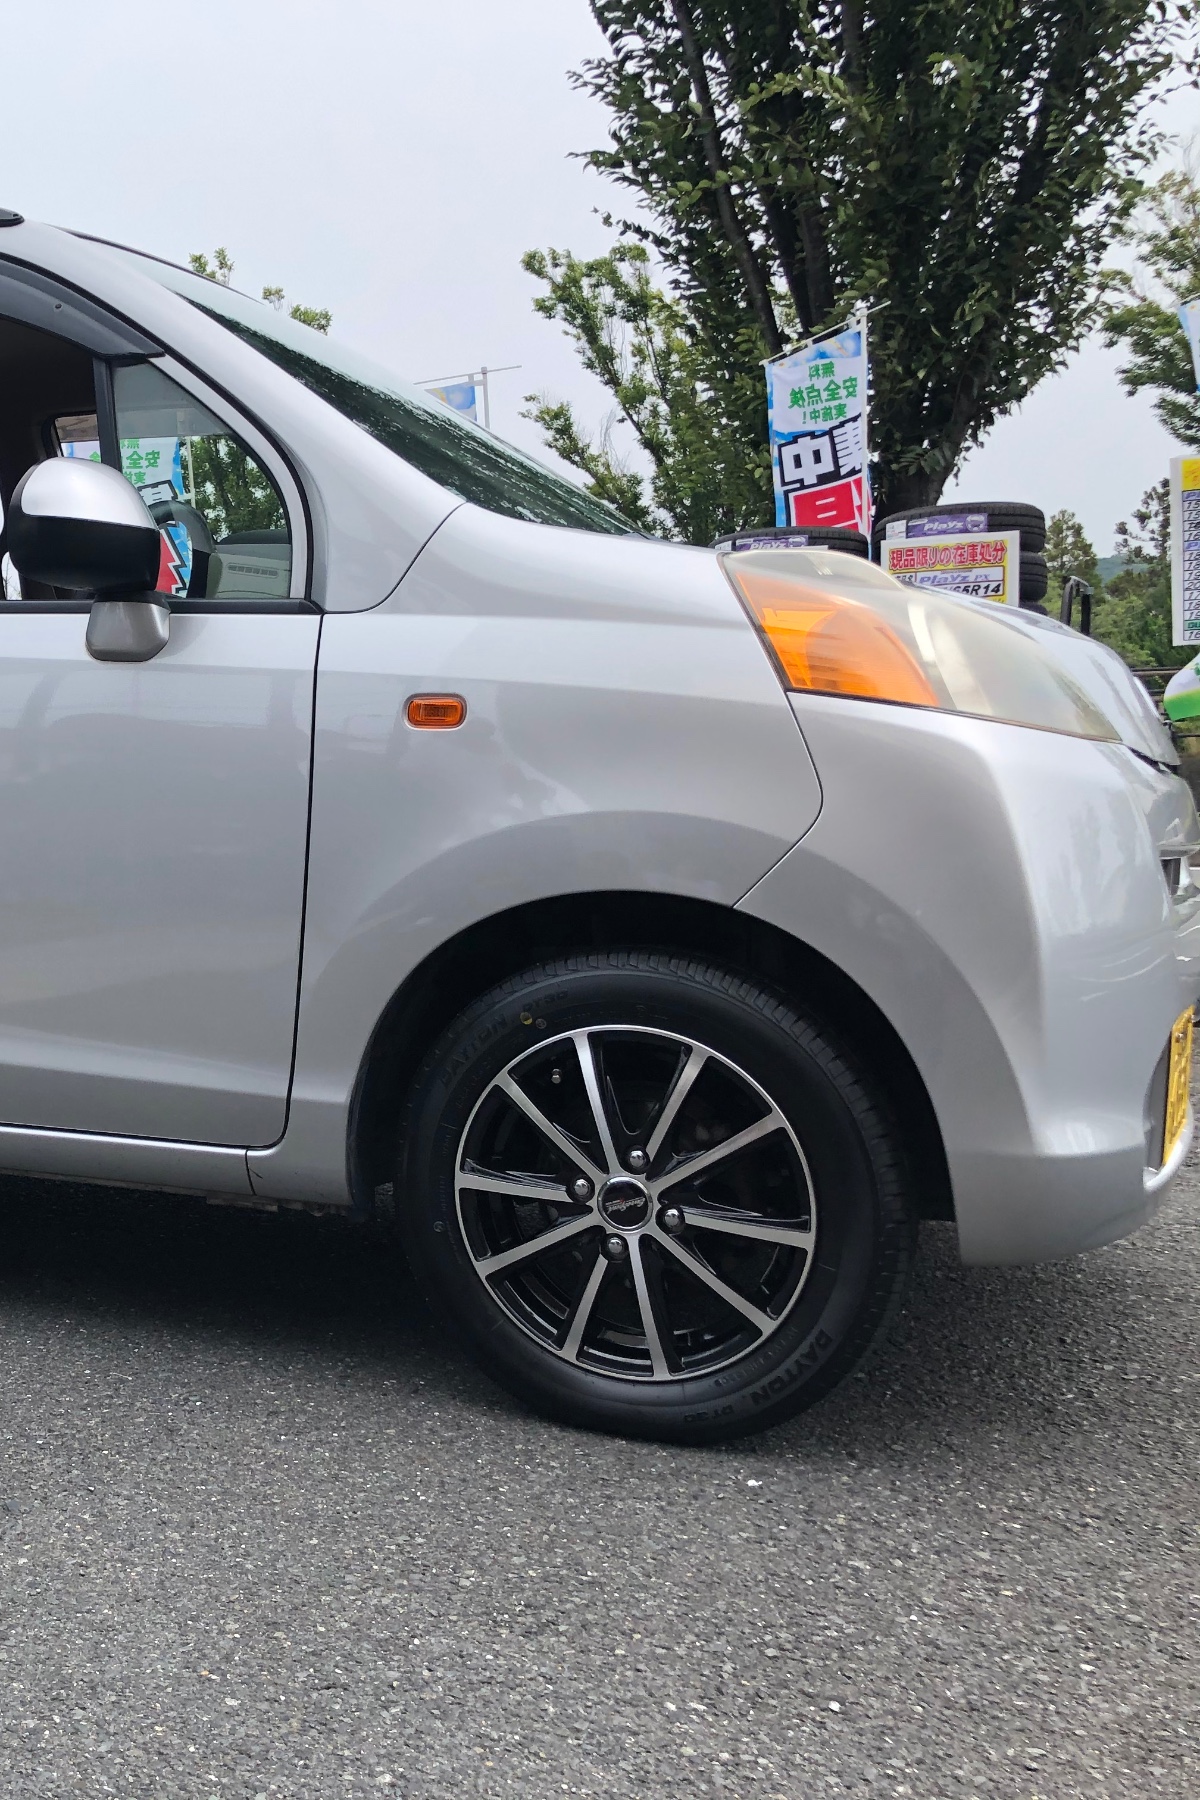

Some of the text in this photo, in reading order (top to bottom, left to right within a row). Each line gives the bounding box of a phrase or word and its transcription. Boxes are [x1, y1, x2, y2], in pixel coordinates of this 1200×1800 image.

[889, 541, 1007, 570] 現品限りの在庫処分
